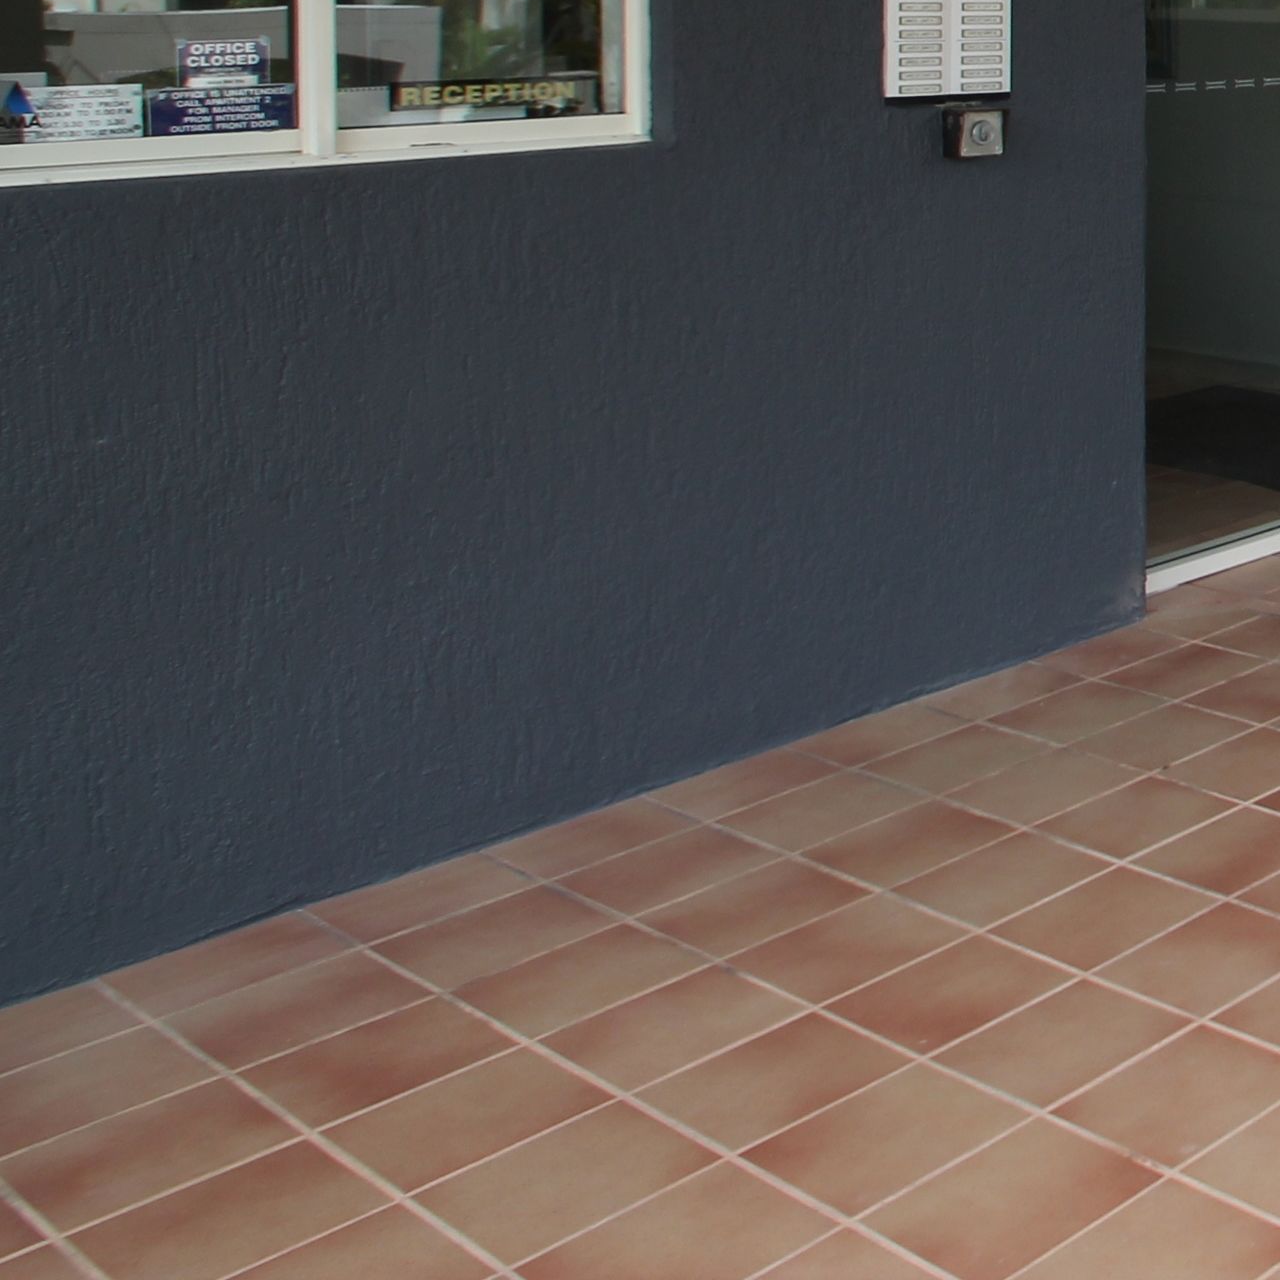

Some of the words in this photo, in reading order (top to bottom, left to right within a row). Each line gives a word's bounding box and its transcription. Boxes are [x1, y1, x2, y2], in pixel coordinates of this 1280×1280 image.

[190, 42, 256, 55] OFFICE
[186, 54, 260, 67] CLOSED
[171, 90, 207, 100] OFFICE
[223, 87, 287, 97] UNATTENDED
[400, 81, 576, 107] RECEPTION
[176, 99, 201, 108] CALL
[204, 96, 262, 106] APARTMENT
[187, 107, 209, 115] FOR
[212, 104, 261, 114] MANAGER
[183, 115, 212, 123] FROM
[215, 112, 266, 122] INTERCOM
[170, 123, 213, 133] OUTSIDE
[216, 121, 249, 131] FRONT
[250, 119, 280, 128] DOOR
